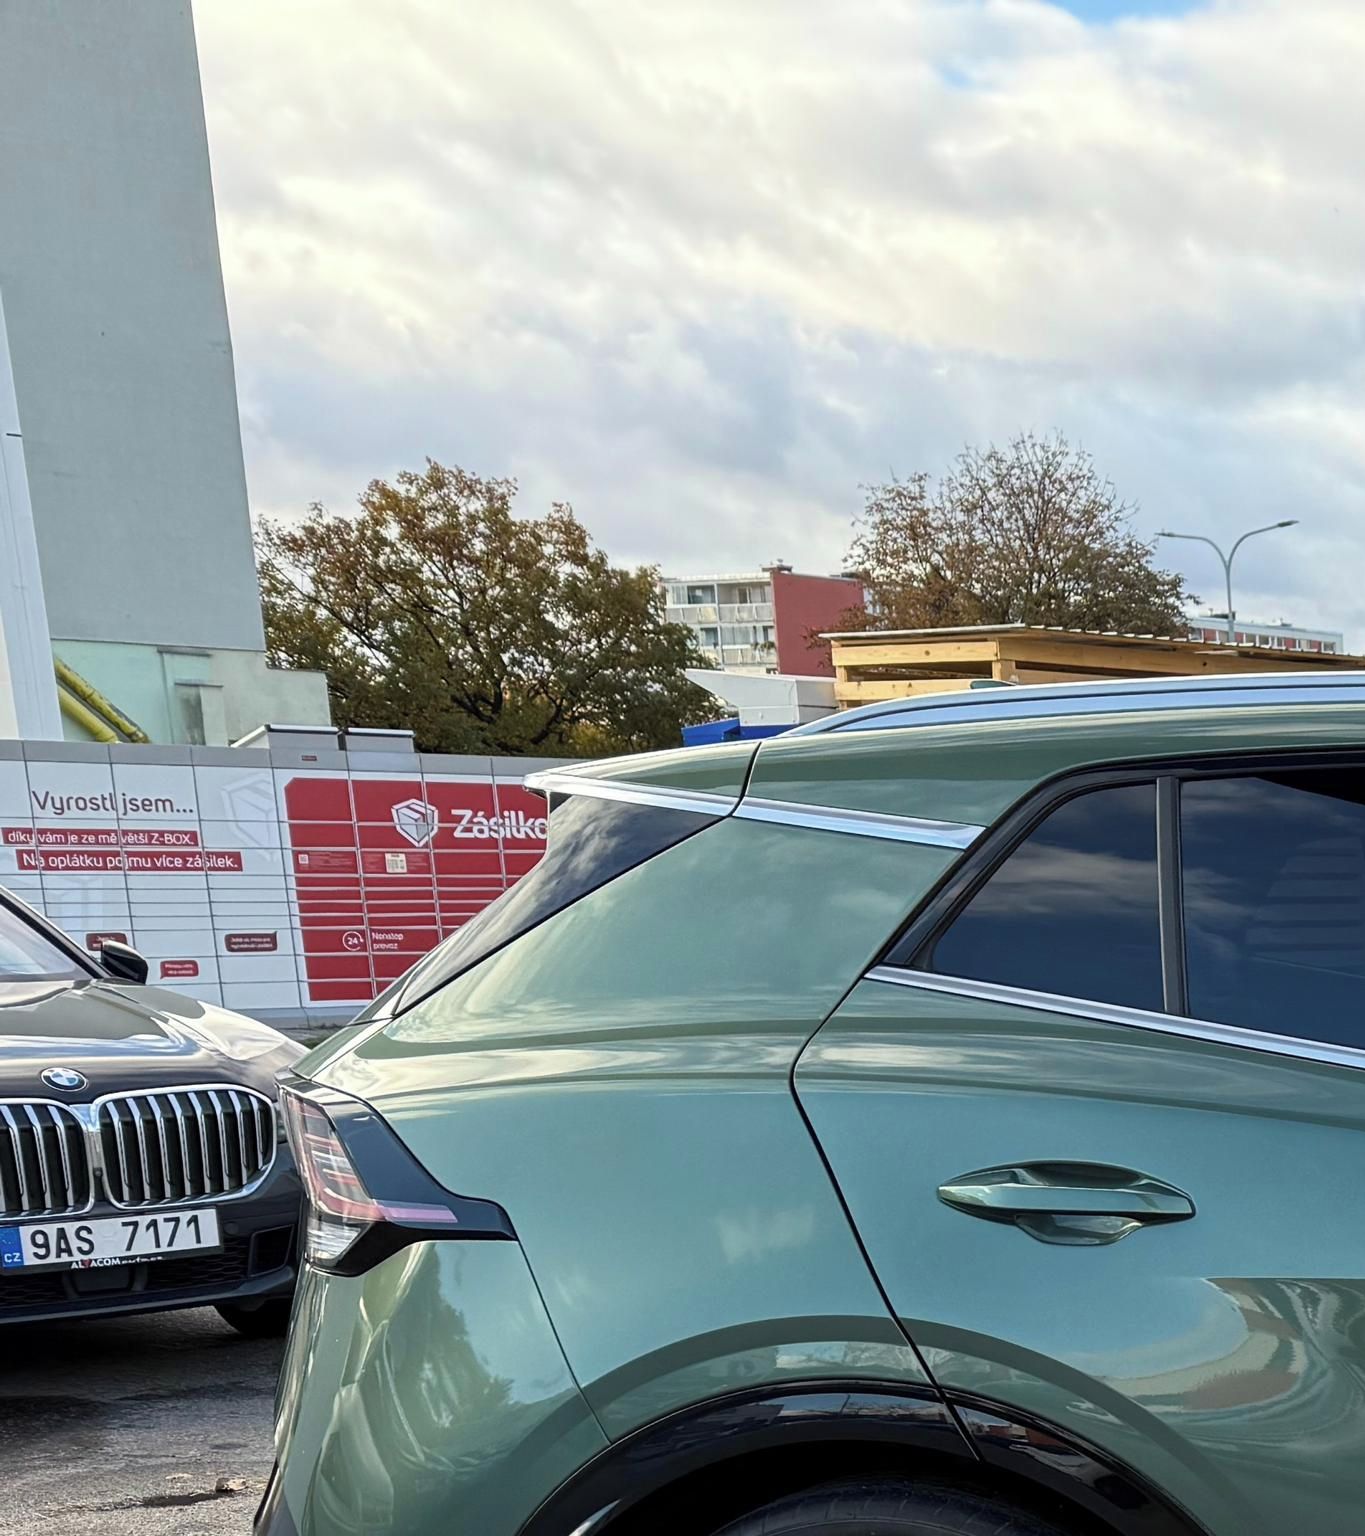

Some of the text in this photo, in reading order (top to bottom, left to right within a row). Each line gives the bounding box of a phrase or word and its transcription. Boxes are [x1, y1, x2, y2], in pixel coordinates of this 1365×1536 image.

[32, 790, 194, 816] Vyrostl jsem...
[7, 830, 194, 845] díky vám je ze mě větší Z-BOX.
[22, 853, 238, 869] Na oplátku pojmu více zásilek.
[346, 931, 404, 946] 24 Nonstop
[29, 1214, 202, 1261] 9AS 7171
[4, 1252, 22, 1263] CZ
